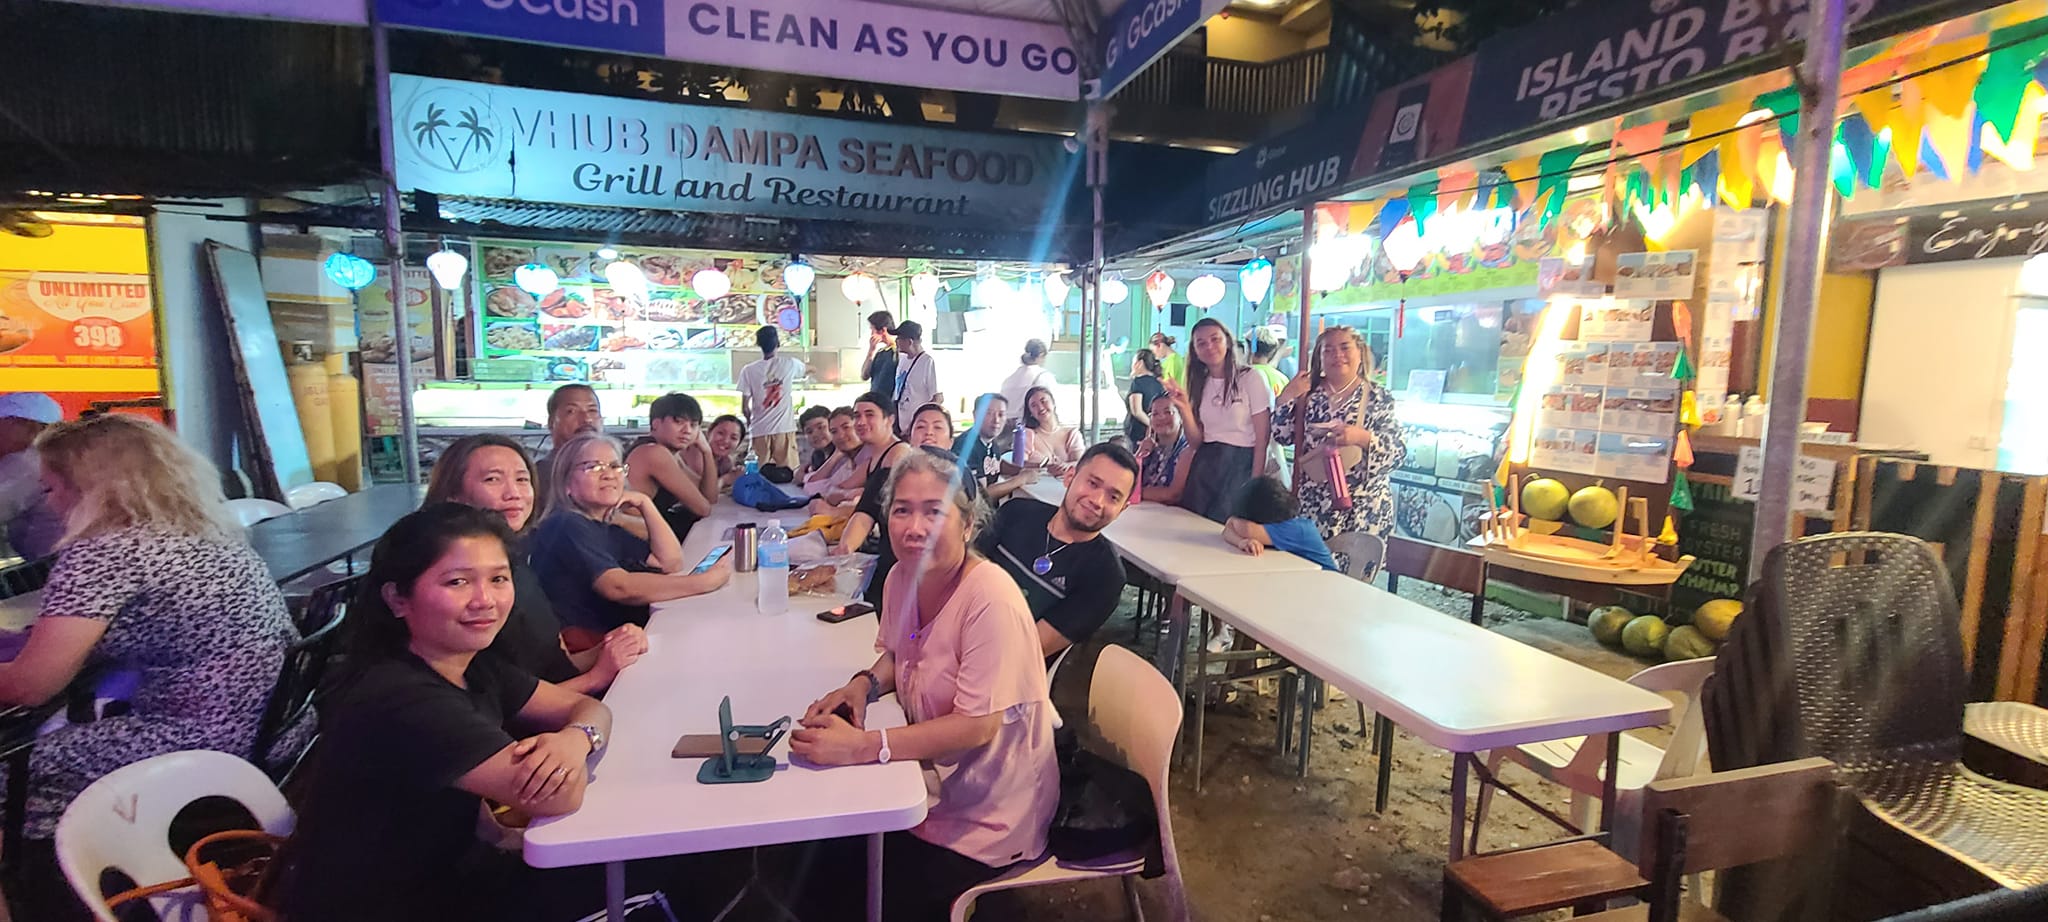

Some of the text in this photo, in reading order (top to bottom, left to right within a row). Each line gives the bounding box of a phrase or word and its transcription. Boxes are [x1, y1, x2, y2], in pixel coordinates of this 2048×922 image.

[482, 0, 638, 26] ash
[687, 3, 1078, 75] CLEAN AS YOU GO
[1127, 0, 1190, 50] GCas
[1516, 7, 1707, 101] ISLAND
[512, 107, 1035, 187] VHUB DAMPA SEAFOOD
[573, 162, 970, 217] Grill and Restaurant
[1208, 155, 1341, 221] SIZZLING HUB
[39, 280, 145, 298] UNLIMITTED
[73, 325, 122, 347] 398
